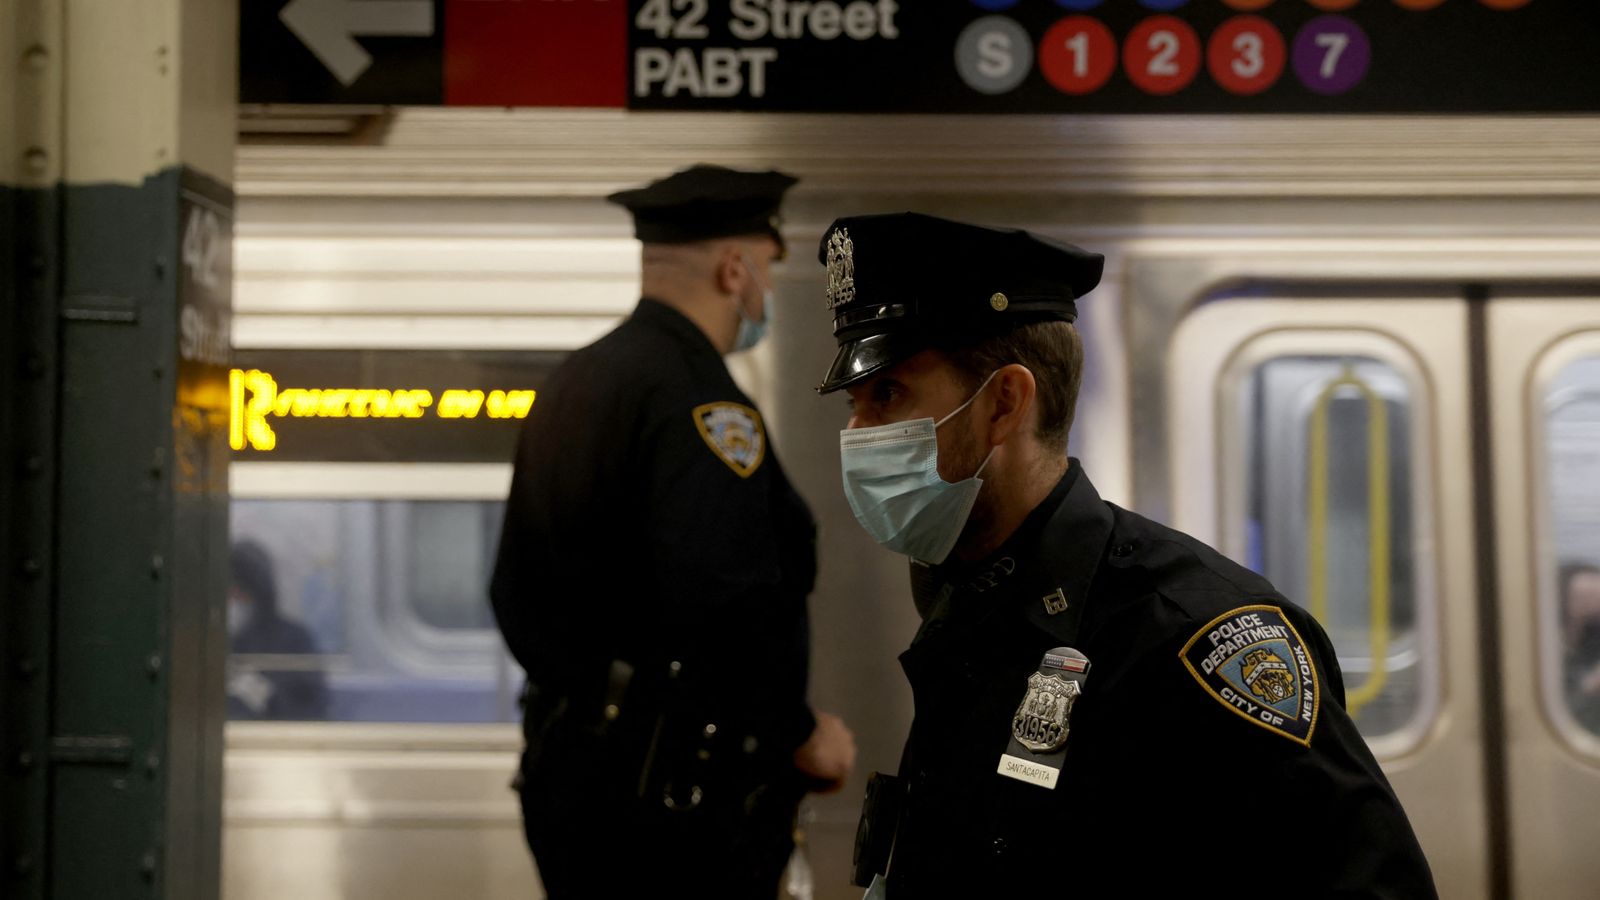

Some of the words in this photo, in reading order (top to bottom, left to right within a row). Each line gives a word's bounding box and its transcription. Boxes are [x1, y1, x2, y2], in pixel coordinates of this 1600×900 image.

[635, 0, 709, 39] 42
[728, 0, 899, 40] Street
[634, 47, 779, 97] PABT
[976, 31, 1014, 78] S
[1064, 31, 1090, 78] 1
[1146, 30, 1181, 77] 2
[1230, 31, 1265, 78] 3
[1315, 33, 1349, 78] 7
[1207, 613, 1263, 647] POLICE
[1201, 625, 1288, 675] DEPARTMENT
[1293, 645, 1313, 686] YORK
[1220, 687, 1258, 714] CITY
[1260, 710, 1284, 726] OF
[1301, 689, 1313, 722] NEW
[1015, 715, 1057, 746] 31956
[1006, 761, 1050, 781] SANTACAPITA
